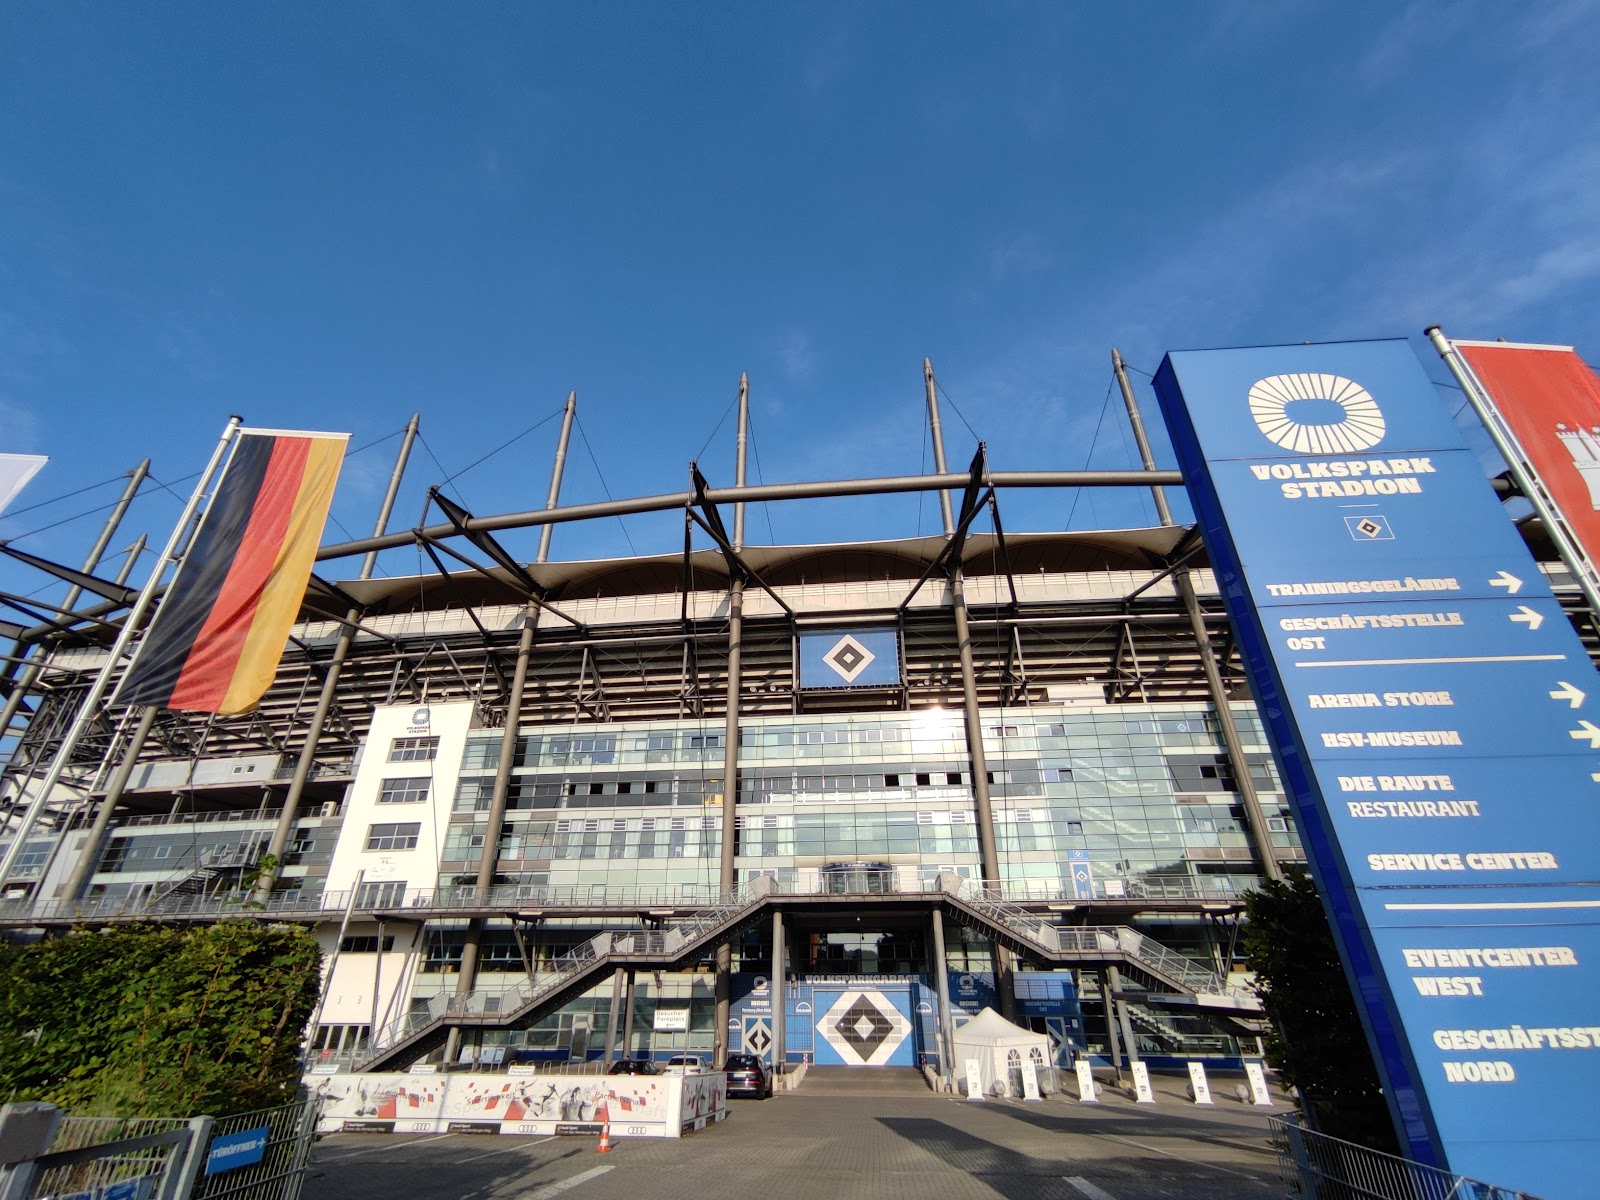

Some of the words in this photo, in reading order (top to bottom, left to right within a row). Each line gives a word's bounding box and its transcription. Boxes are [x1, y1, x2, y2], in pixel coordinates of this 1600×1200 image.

[1250, 457, 1437, 480] VOLKSPARK
[1280, 477, 1423, 499] STADION
[1266, 577, 1461, 596] TRAININGSGELÄNDE
[1279, 612, 1465, 632] GESCHÄFTSSTELLE
[1286, 636, 1326, 651] OST
[1308, 692, 1383, 709] ARENA
[1383, 690, 1454, 707] STORE
[1320, 730, 1462, 748] HSV-MUSEUM
[1337, 775, 1376, 792] DIE
[1376, 774, 1455, 792] RAUTE
[1346, 799, 1480, 818] RESTAURANT
[1367, 853, 1466, 872] SERVICE
[1466, 851, 1559, 871] CENTER
[1401, 946, 1578, 968] EVENTCENTER
[804, 974, 920, 985] VOLKSPARKGARAGE
[1412, 976, 1483, 996] WEST
[1442, 1061, 1517, 1083] NORD
